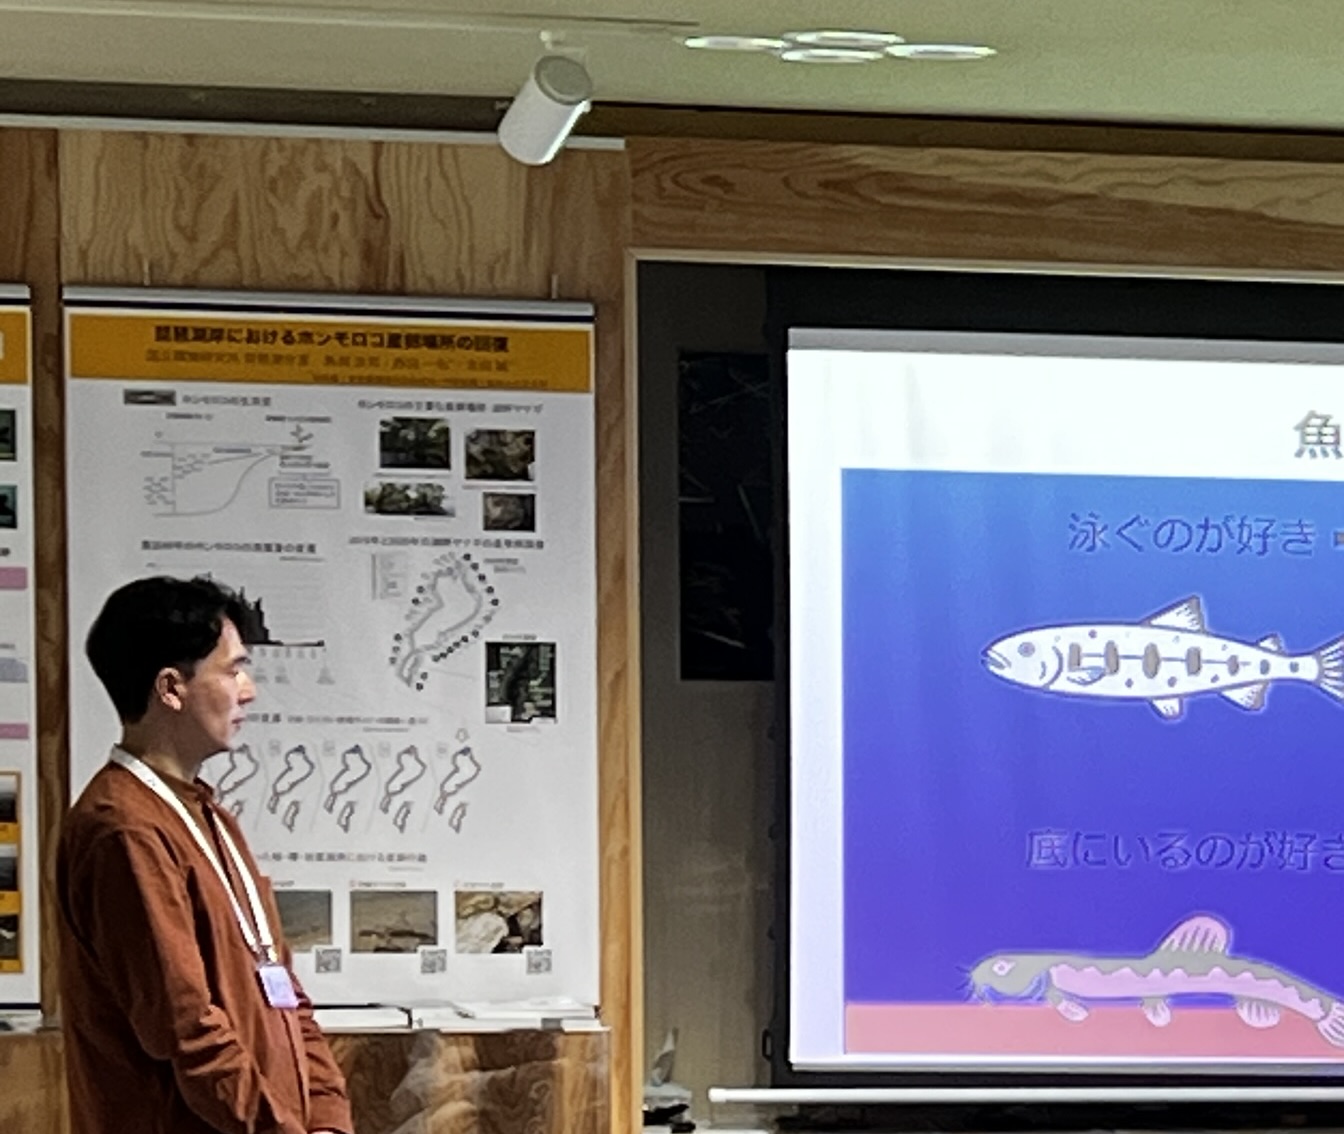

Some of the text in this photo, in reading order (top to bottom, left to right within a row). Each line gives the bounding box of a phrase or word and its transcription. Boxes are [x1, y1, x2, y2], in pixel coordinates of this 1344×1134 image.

[1068, 511, 1317, 557] 泳ぐのが好き
